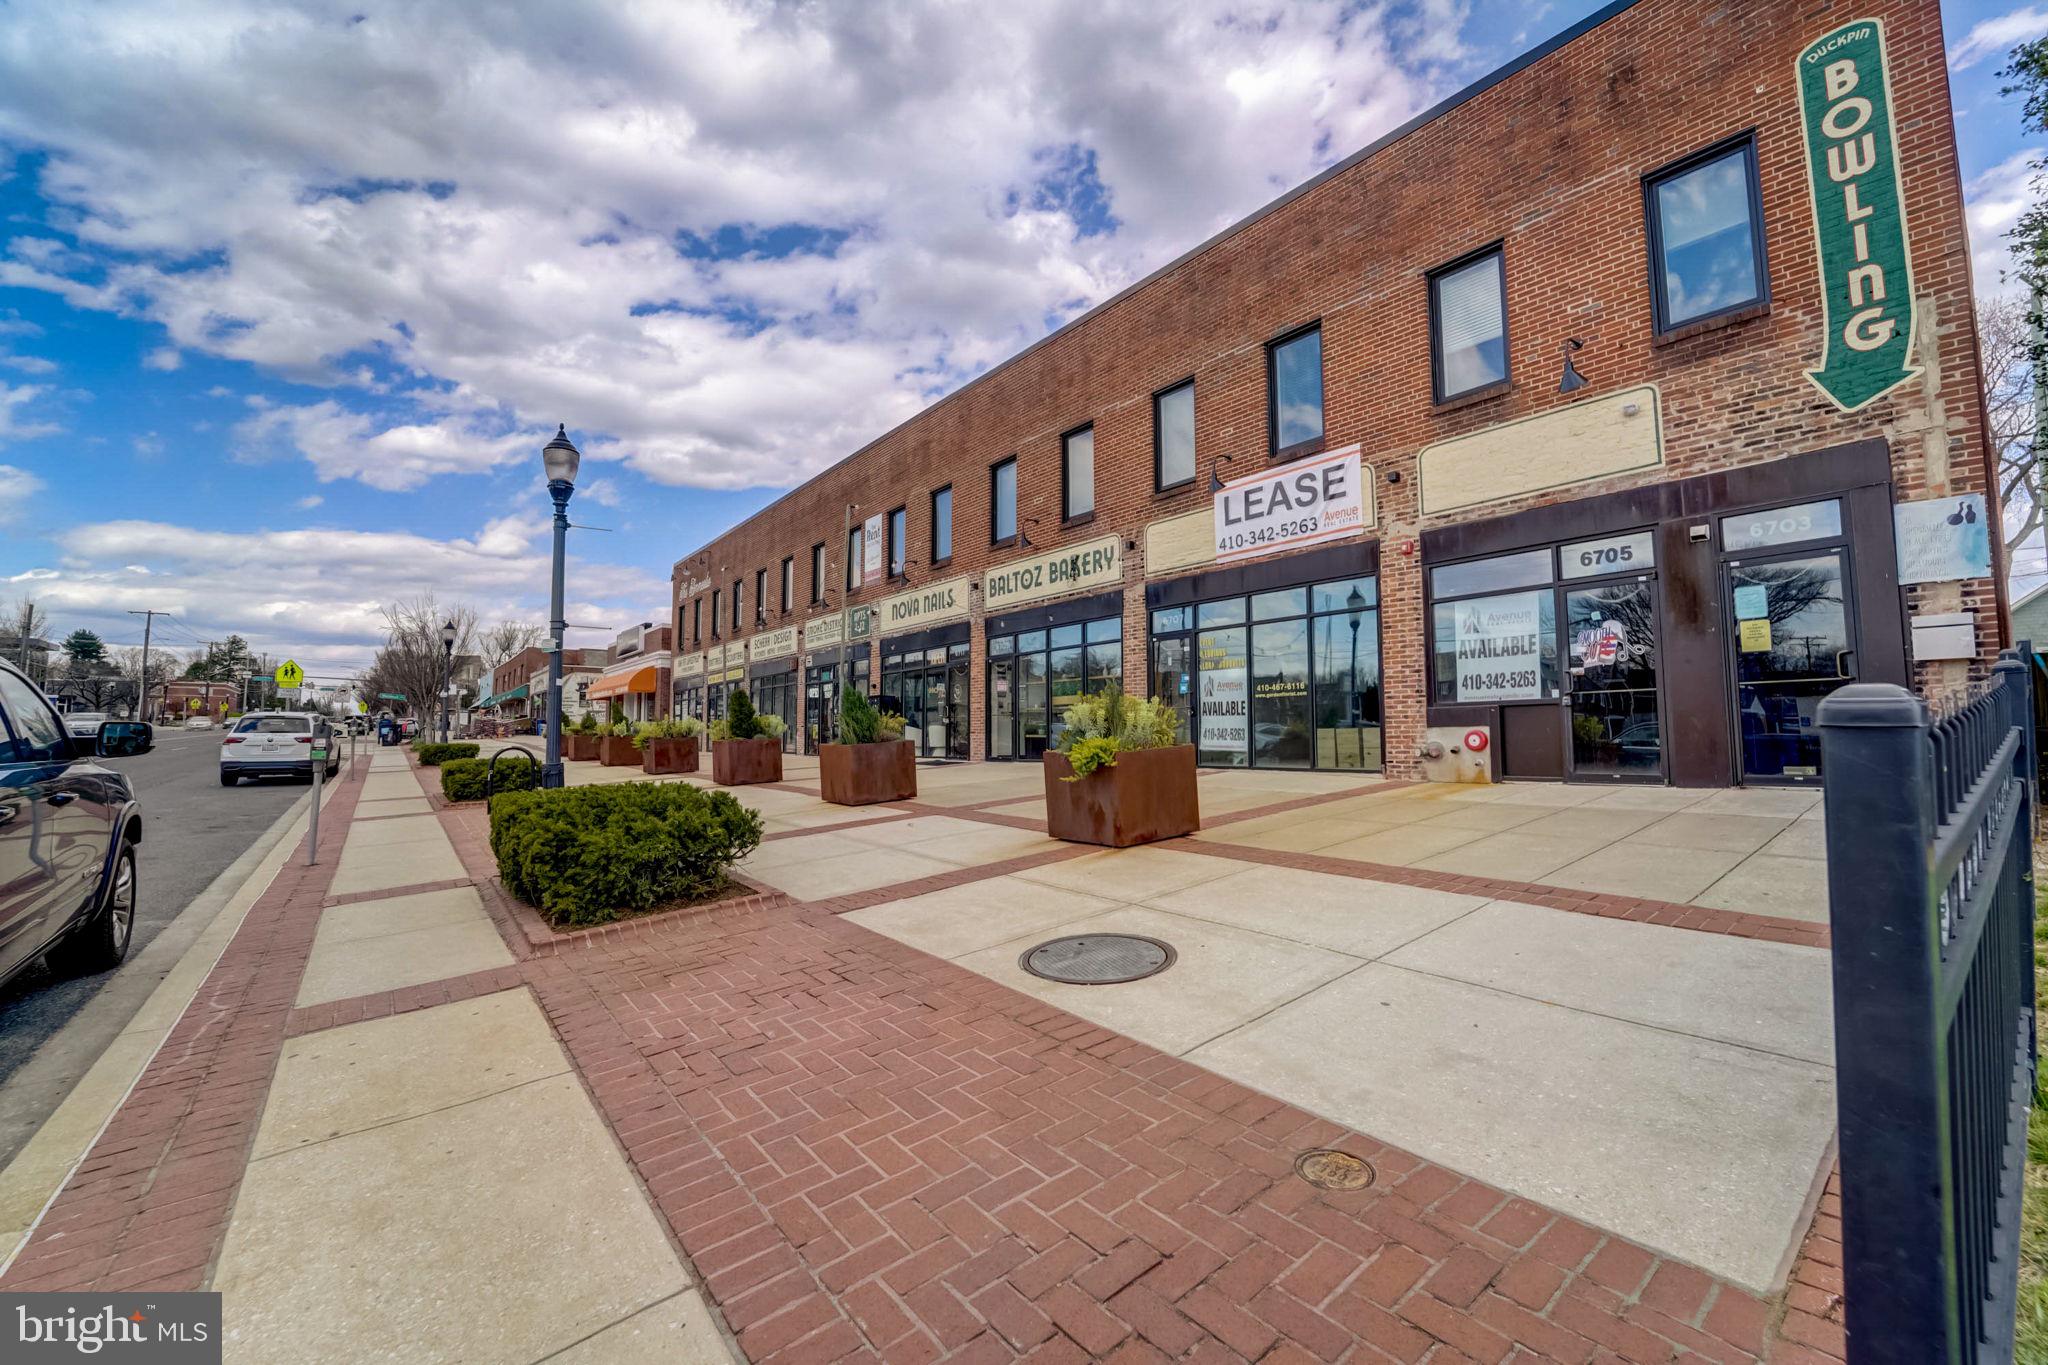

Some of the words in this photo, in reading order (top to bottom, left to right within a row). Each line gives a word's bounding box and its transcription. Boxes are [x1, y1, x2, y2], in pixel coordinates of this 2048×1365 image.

[1223, 463, 1347, 527] LEASE
[1324, 506, 1359, 521] Avenue
[1219, 517, 1318, 551] 410-342-5263
[1750, 516, 1811, 537] 6703
[1580, 545, 1633, 567] 6705
[988, 565, 1043, 598] BALTOZ
[1049, 545, 1115, 584] BAKERY
[891, 600, 920, 621] NOVA
[923, 588, 954, 614] NAILS
[824, 618, 843, 631] DISTRIC
[1487, 610, 1532, 622] Avenue
[773, 630, 792, 645] DESIGN
[1458, 634, 1537, 659] AVAILABLE
[1462, 670, 1537, 691] 410-342-5263
[1202, 700, 1246, 716] AVAILABLE
[1203, 727, 1246, 742] 410-342-5263
